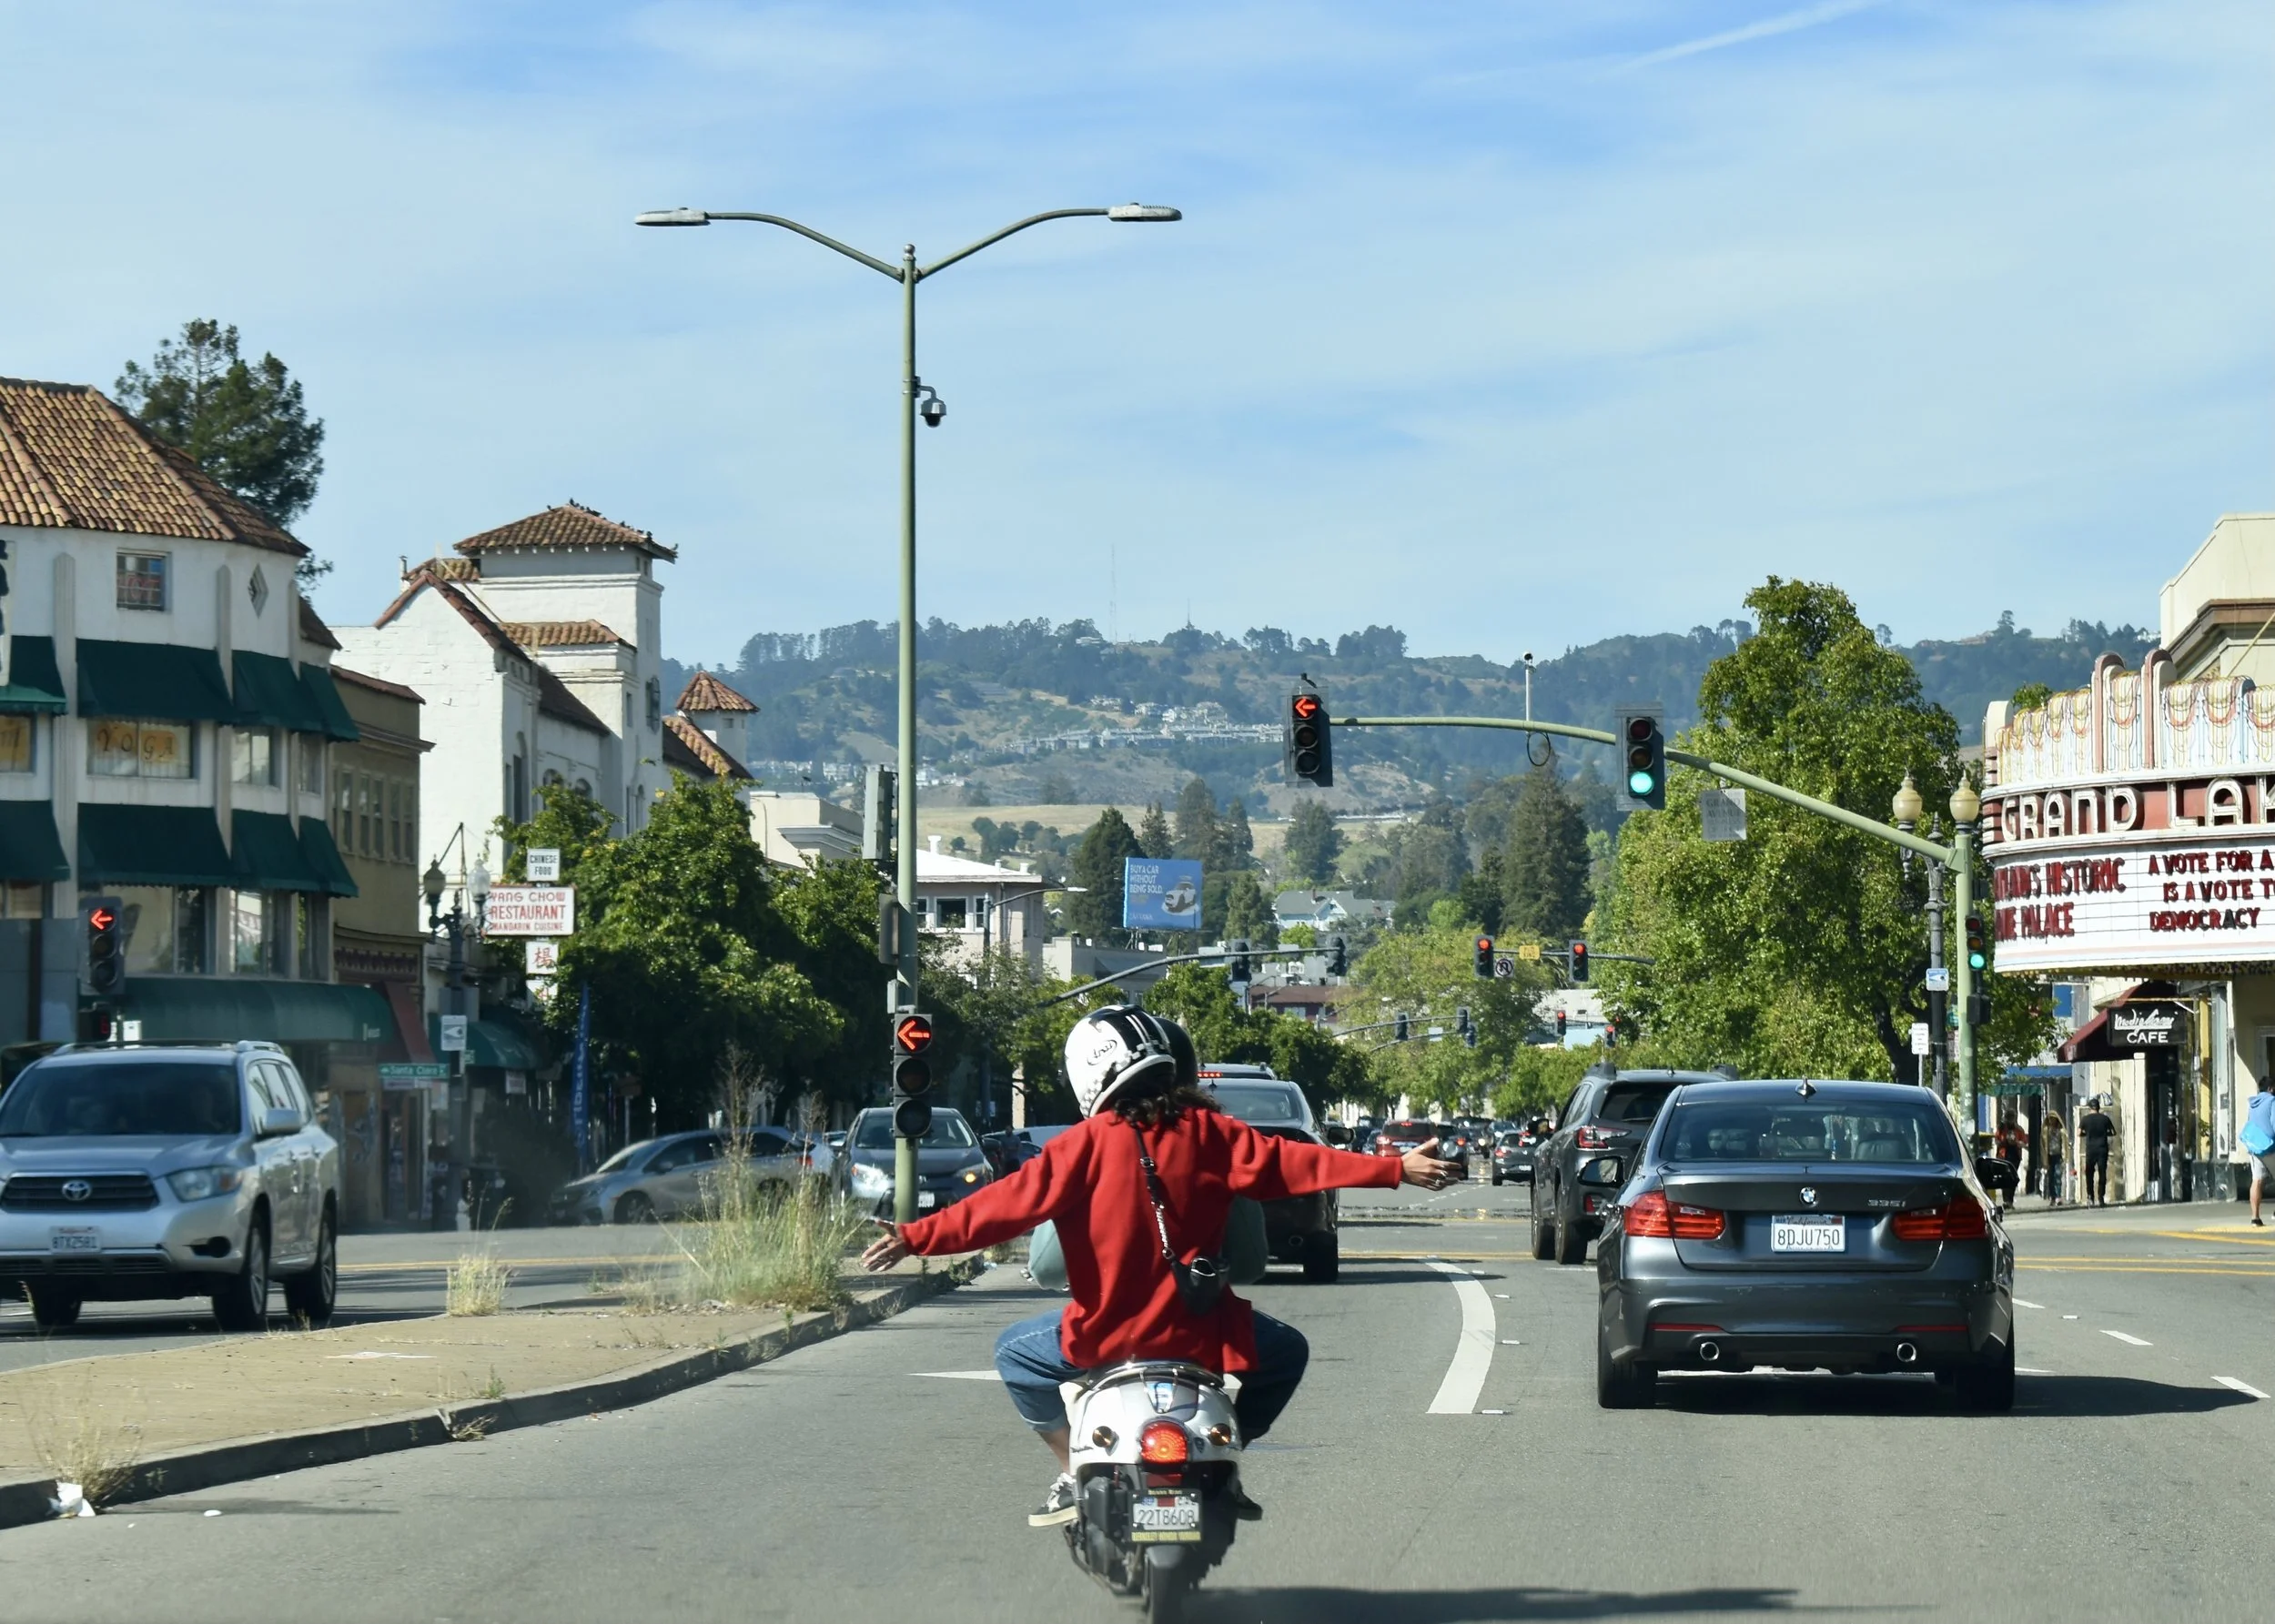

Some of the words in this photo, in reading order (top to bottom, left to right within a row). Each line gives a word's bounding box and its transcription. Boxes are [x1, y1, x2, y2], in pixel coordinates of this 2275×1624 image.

[2002, 785, 2138, 842] GRAND
[530, 854, 558, 863] CHINESE
[2148, 854, 2160, 876] A
[2161, 852, 2209, 876] VOTE
[2215, 850, 2254, 873] FOR
[2260, 849, 2275, 871] A
[534, 866, 552, 875] FOOD
[1130, 864, 1143, 874] BUY
[1147, 865, 1159, 874] CAR
[2045, 857, 2128, 897] HISTORIC
[1129, 874, 1158, 884] WITHOUT
[1129, 884, 1147, 893] BEING
[2163, 882, 2179, 903] IS
[2185, 881, 2196, 902] A
[2199, 879, 2254, 903] VOTE
[2260, 878, 2275, 900] T
[491, 892, 524, 903] YANG
[529, 892, 566, 903] CHOW
[491, 905, 566, 920] RESTAURANT
[2021, 902, 2075, 939] PALACE
[2149, 907, 2260, 932] DEMOCRACY
[2127, 1032, 2168, 1044] CAFE
[1777, 1229, 1840, 1246] 8DJU750
[1138, 1509, 1196, 1526] 22T8608
